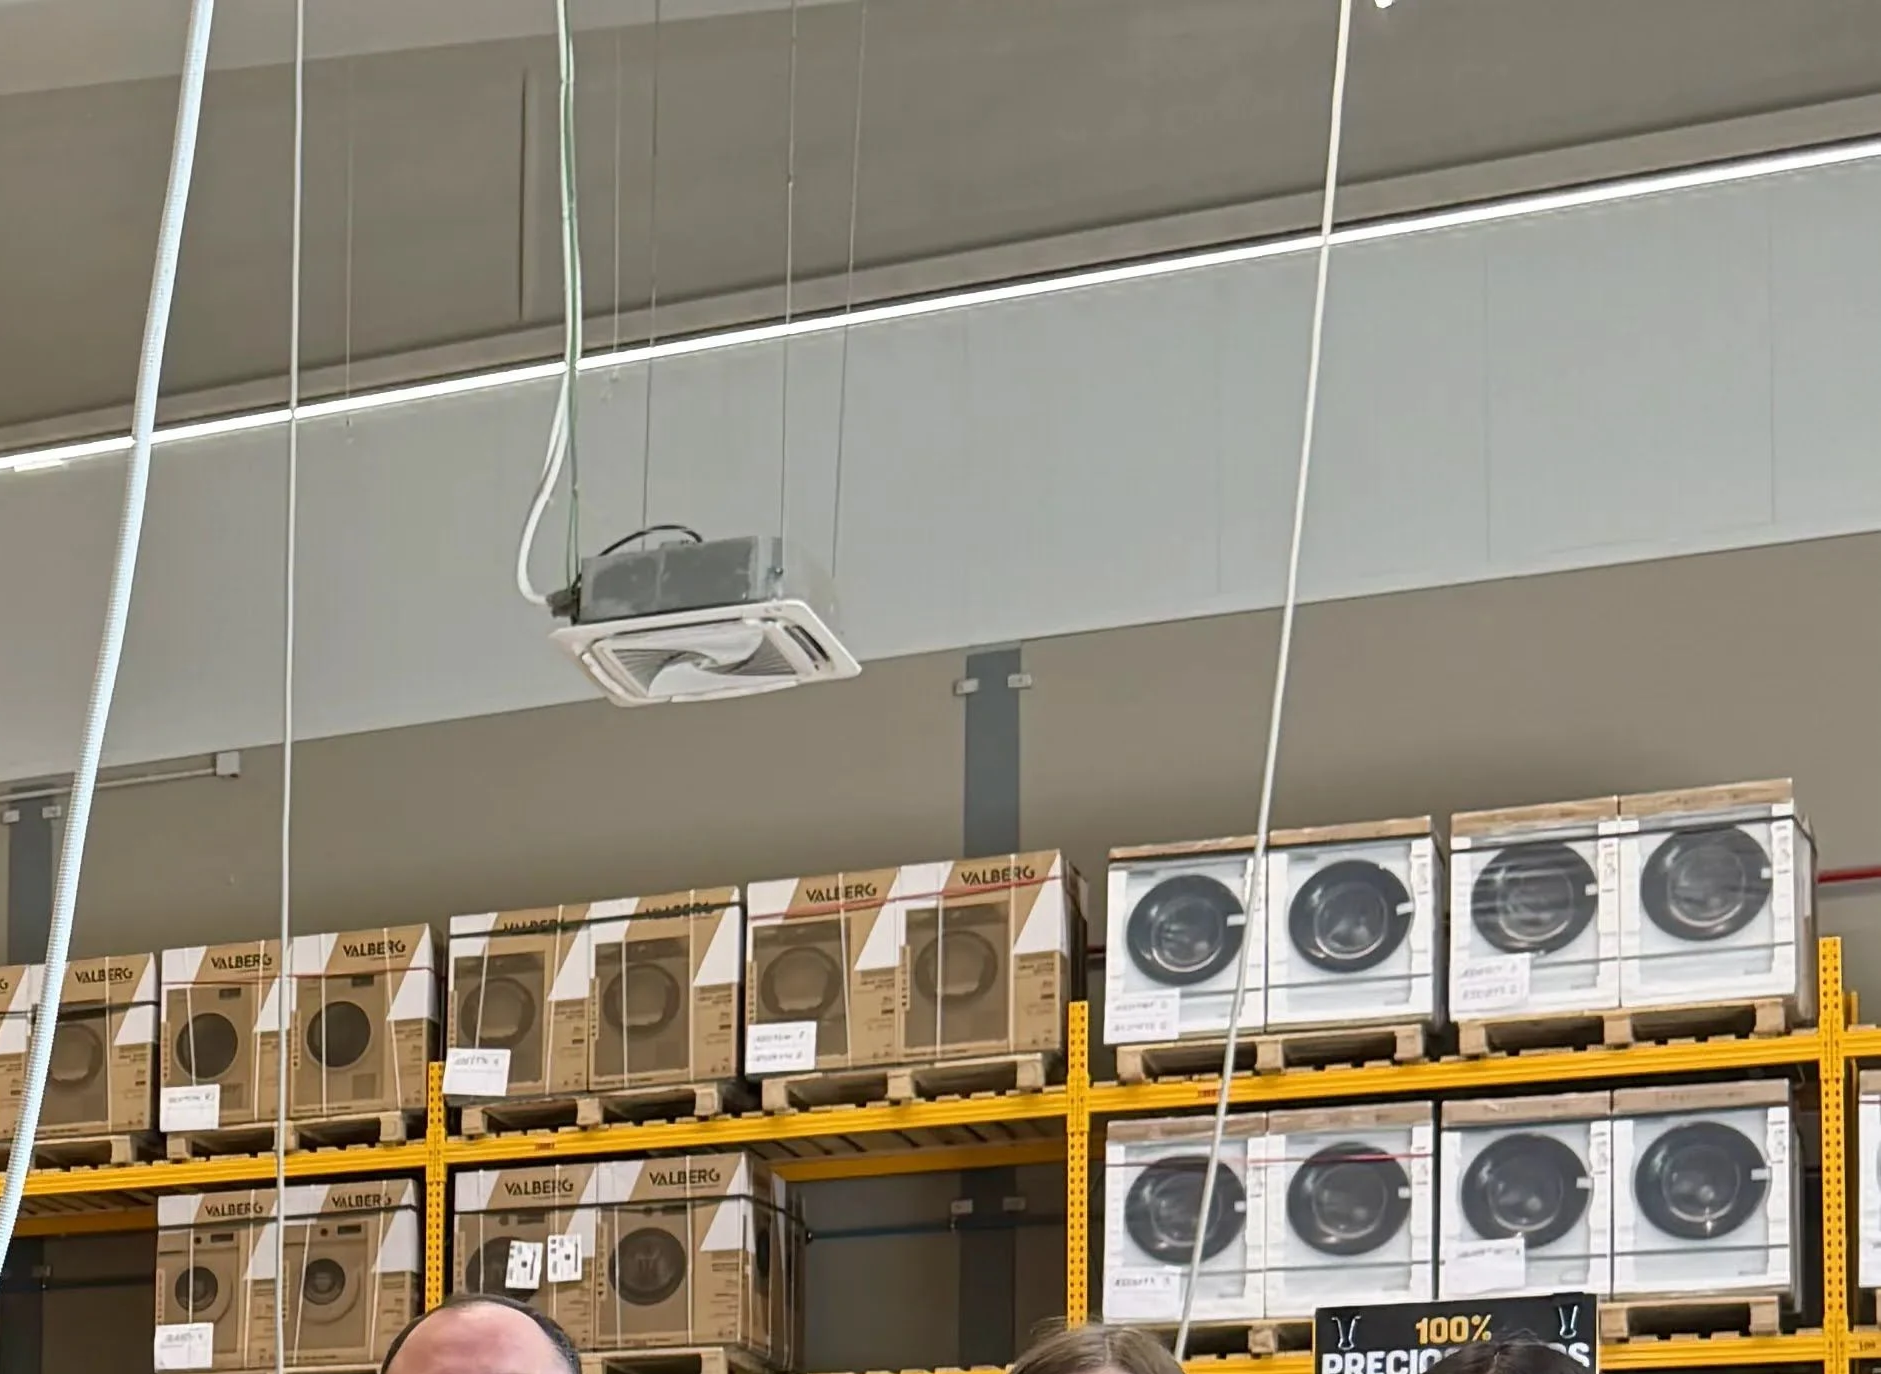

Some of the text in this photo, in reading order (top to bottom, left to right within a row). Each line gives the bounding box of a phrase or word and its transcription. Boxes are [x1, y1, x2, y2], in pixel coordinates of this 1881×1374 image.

[961, 865, 1035, 886] VALBERG
[343, 939, 406, 958] VALBERG
[210, 953, 272, 970] VALBERG
[74, 967, 134, 985] VALBERG
[649, 1168, 721, 1186] VALBERG
[505, 1178, 574, 1196] VALBERG
[205, 1201, 263, 1217] VALBERG
[1415, 1313, 1492, 1344] 100%
